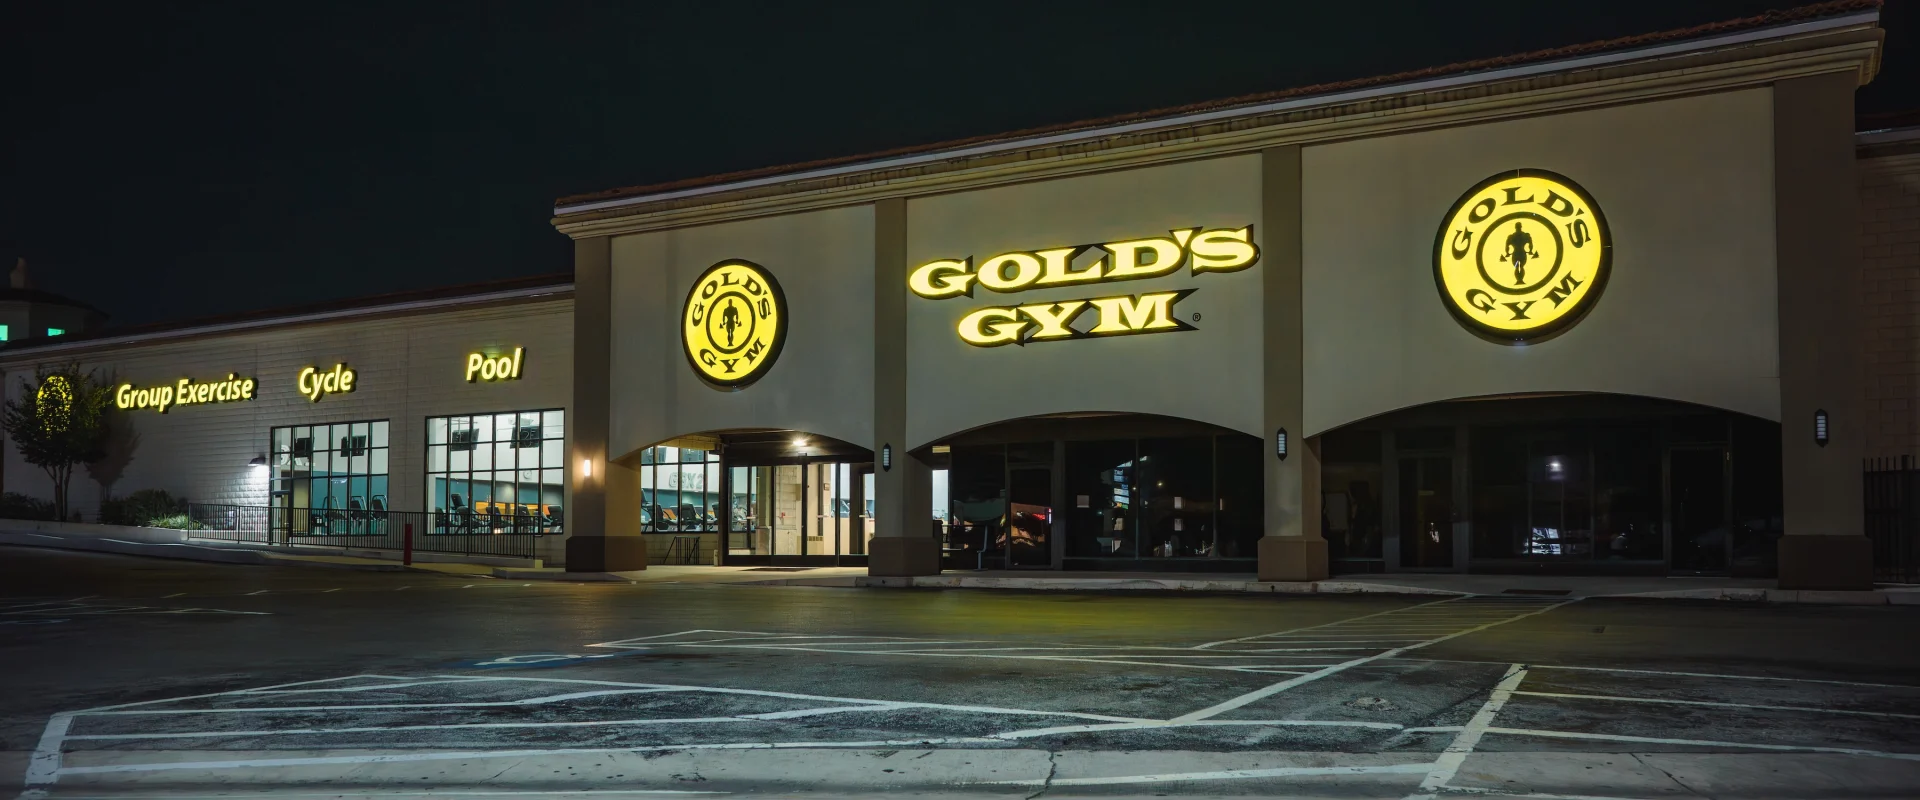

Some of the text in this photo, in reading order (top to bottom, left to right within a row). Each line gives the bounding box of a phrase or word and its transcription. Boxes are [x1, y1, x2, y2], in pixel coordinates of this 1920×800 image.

[1451, 186, 1592, 261] GOLD'S
[909, 228, 1255, 296] GOLD'S
[692, 272, 772, 327] GOLD'S
[958, 292, 1180, 345] GYM
[1465, 270, 1584, 321] GYM
[466, 347, 522, 381] Pool
[699, 336, 767, 374] GYM
[117, 373, 254, 412] Group Exercise
[299, 363, 354, 401] Cycle
